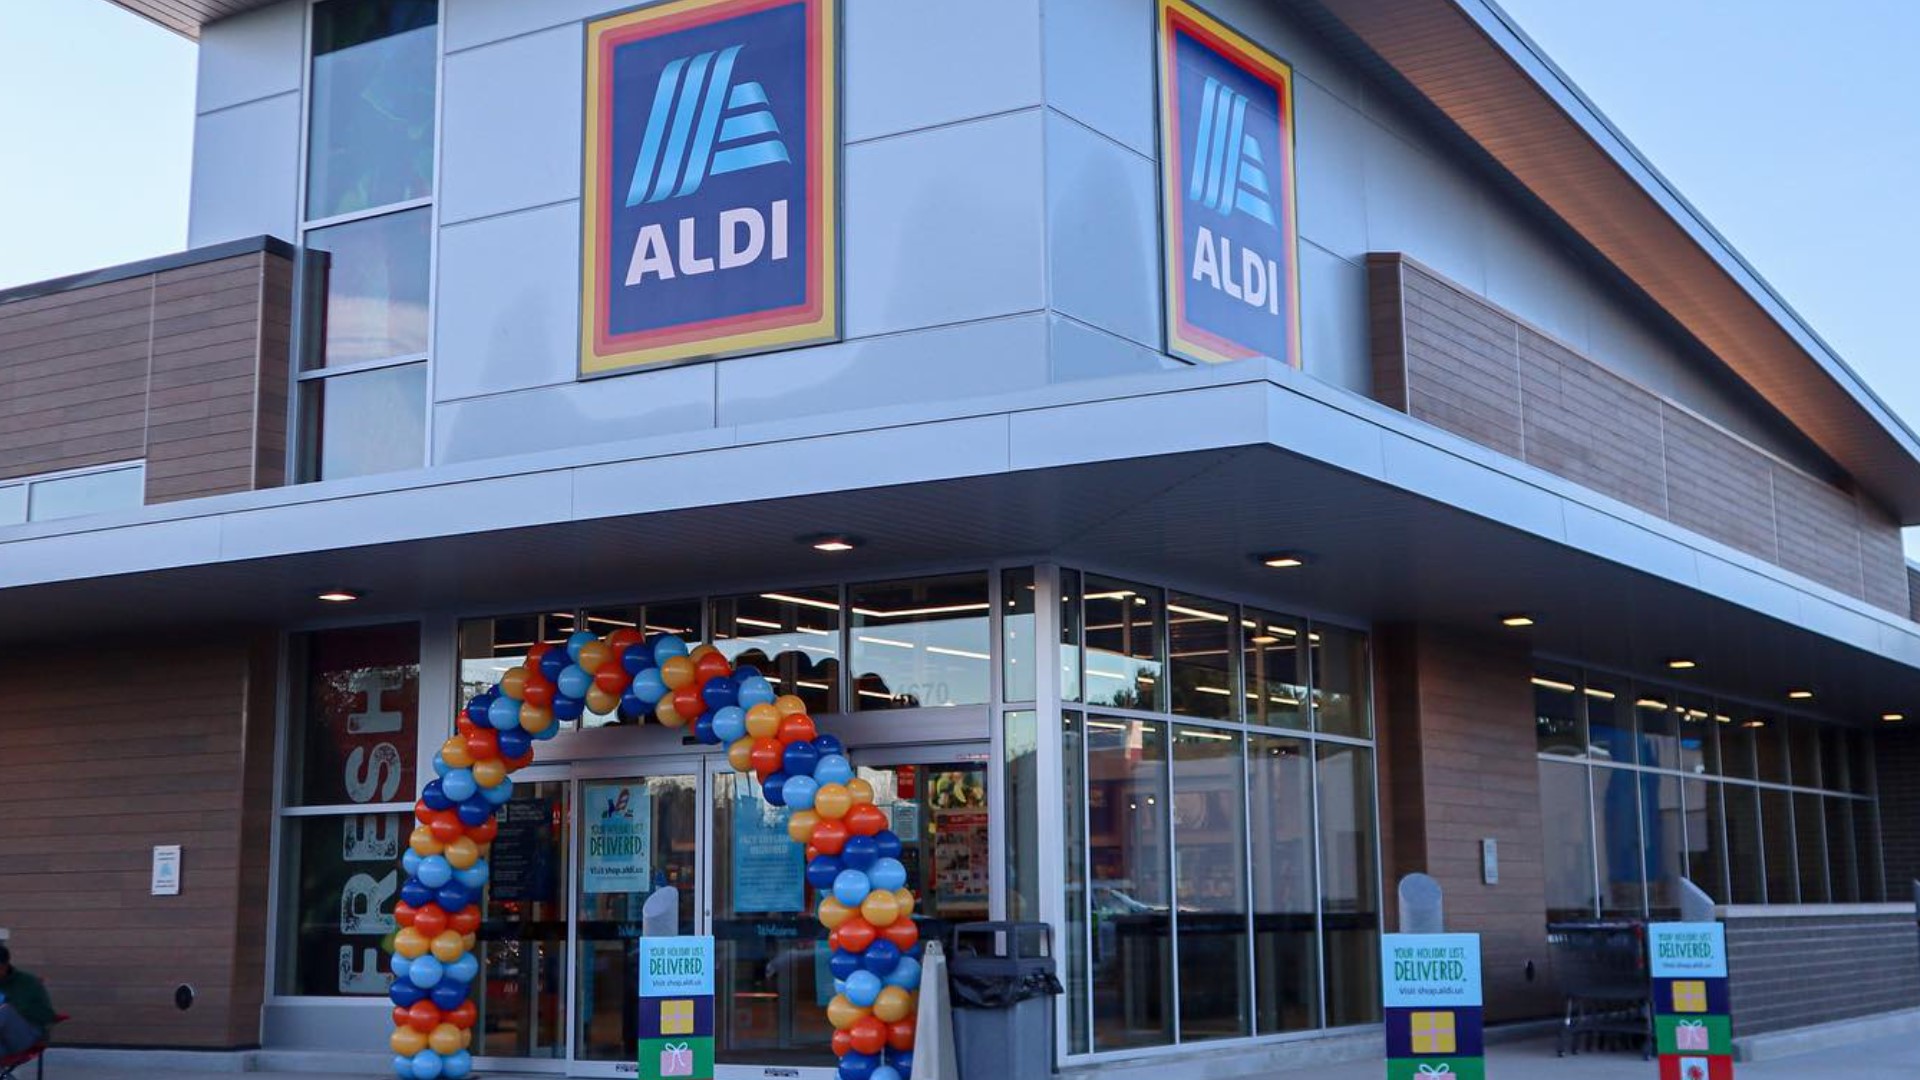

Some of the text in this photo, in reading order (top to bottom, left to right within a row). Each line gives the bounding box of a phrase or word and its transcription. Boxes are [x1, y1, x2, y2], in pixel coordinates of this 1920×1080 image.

[625, 199, 788, 286] ALDI
[1192, 225, 1279, 316] ALDI
[338, 667, 403, 994] FRESH
[649, 957, 705, 976] DELIVERED.
[1394, 947, 1414, 959] YOUR
[1417, 947, 1447, 958] HOLIDAY
[1394, 959, 1468, 982] DELIVERED.
